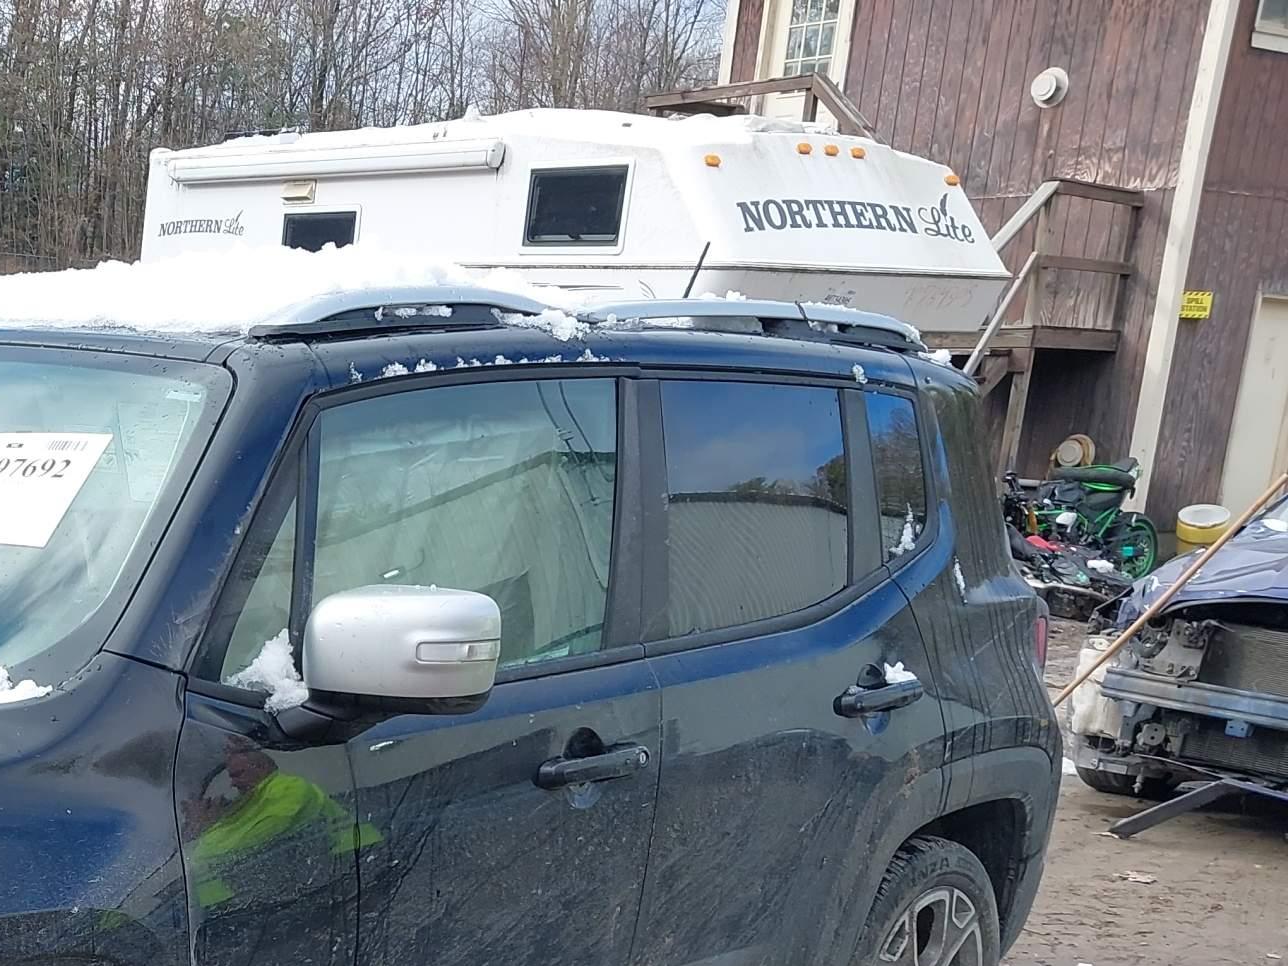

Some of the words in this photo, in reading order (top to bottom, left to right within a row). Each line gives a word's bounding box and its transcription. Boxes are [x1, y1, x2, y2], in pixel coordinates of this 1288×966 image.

[158, 219, 223, 237] NORTHERN
[223, 209, 245, 237] Lite
[735, 198, 918, 234] NORTHERN
[918, 193, 976, 244] Lite
[1180, 304, 1209, 313] STATION
